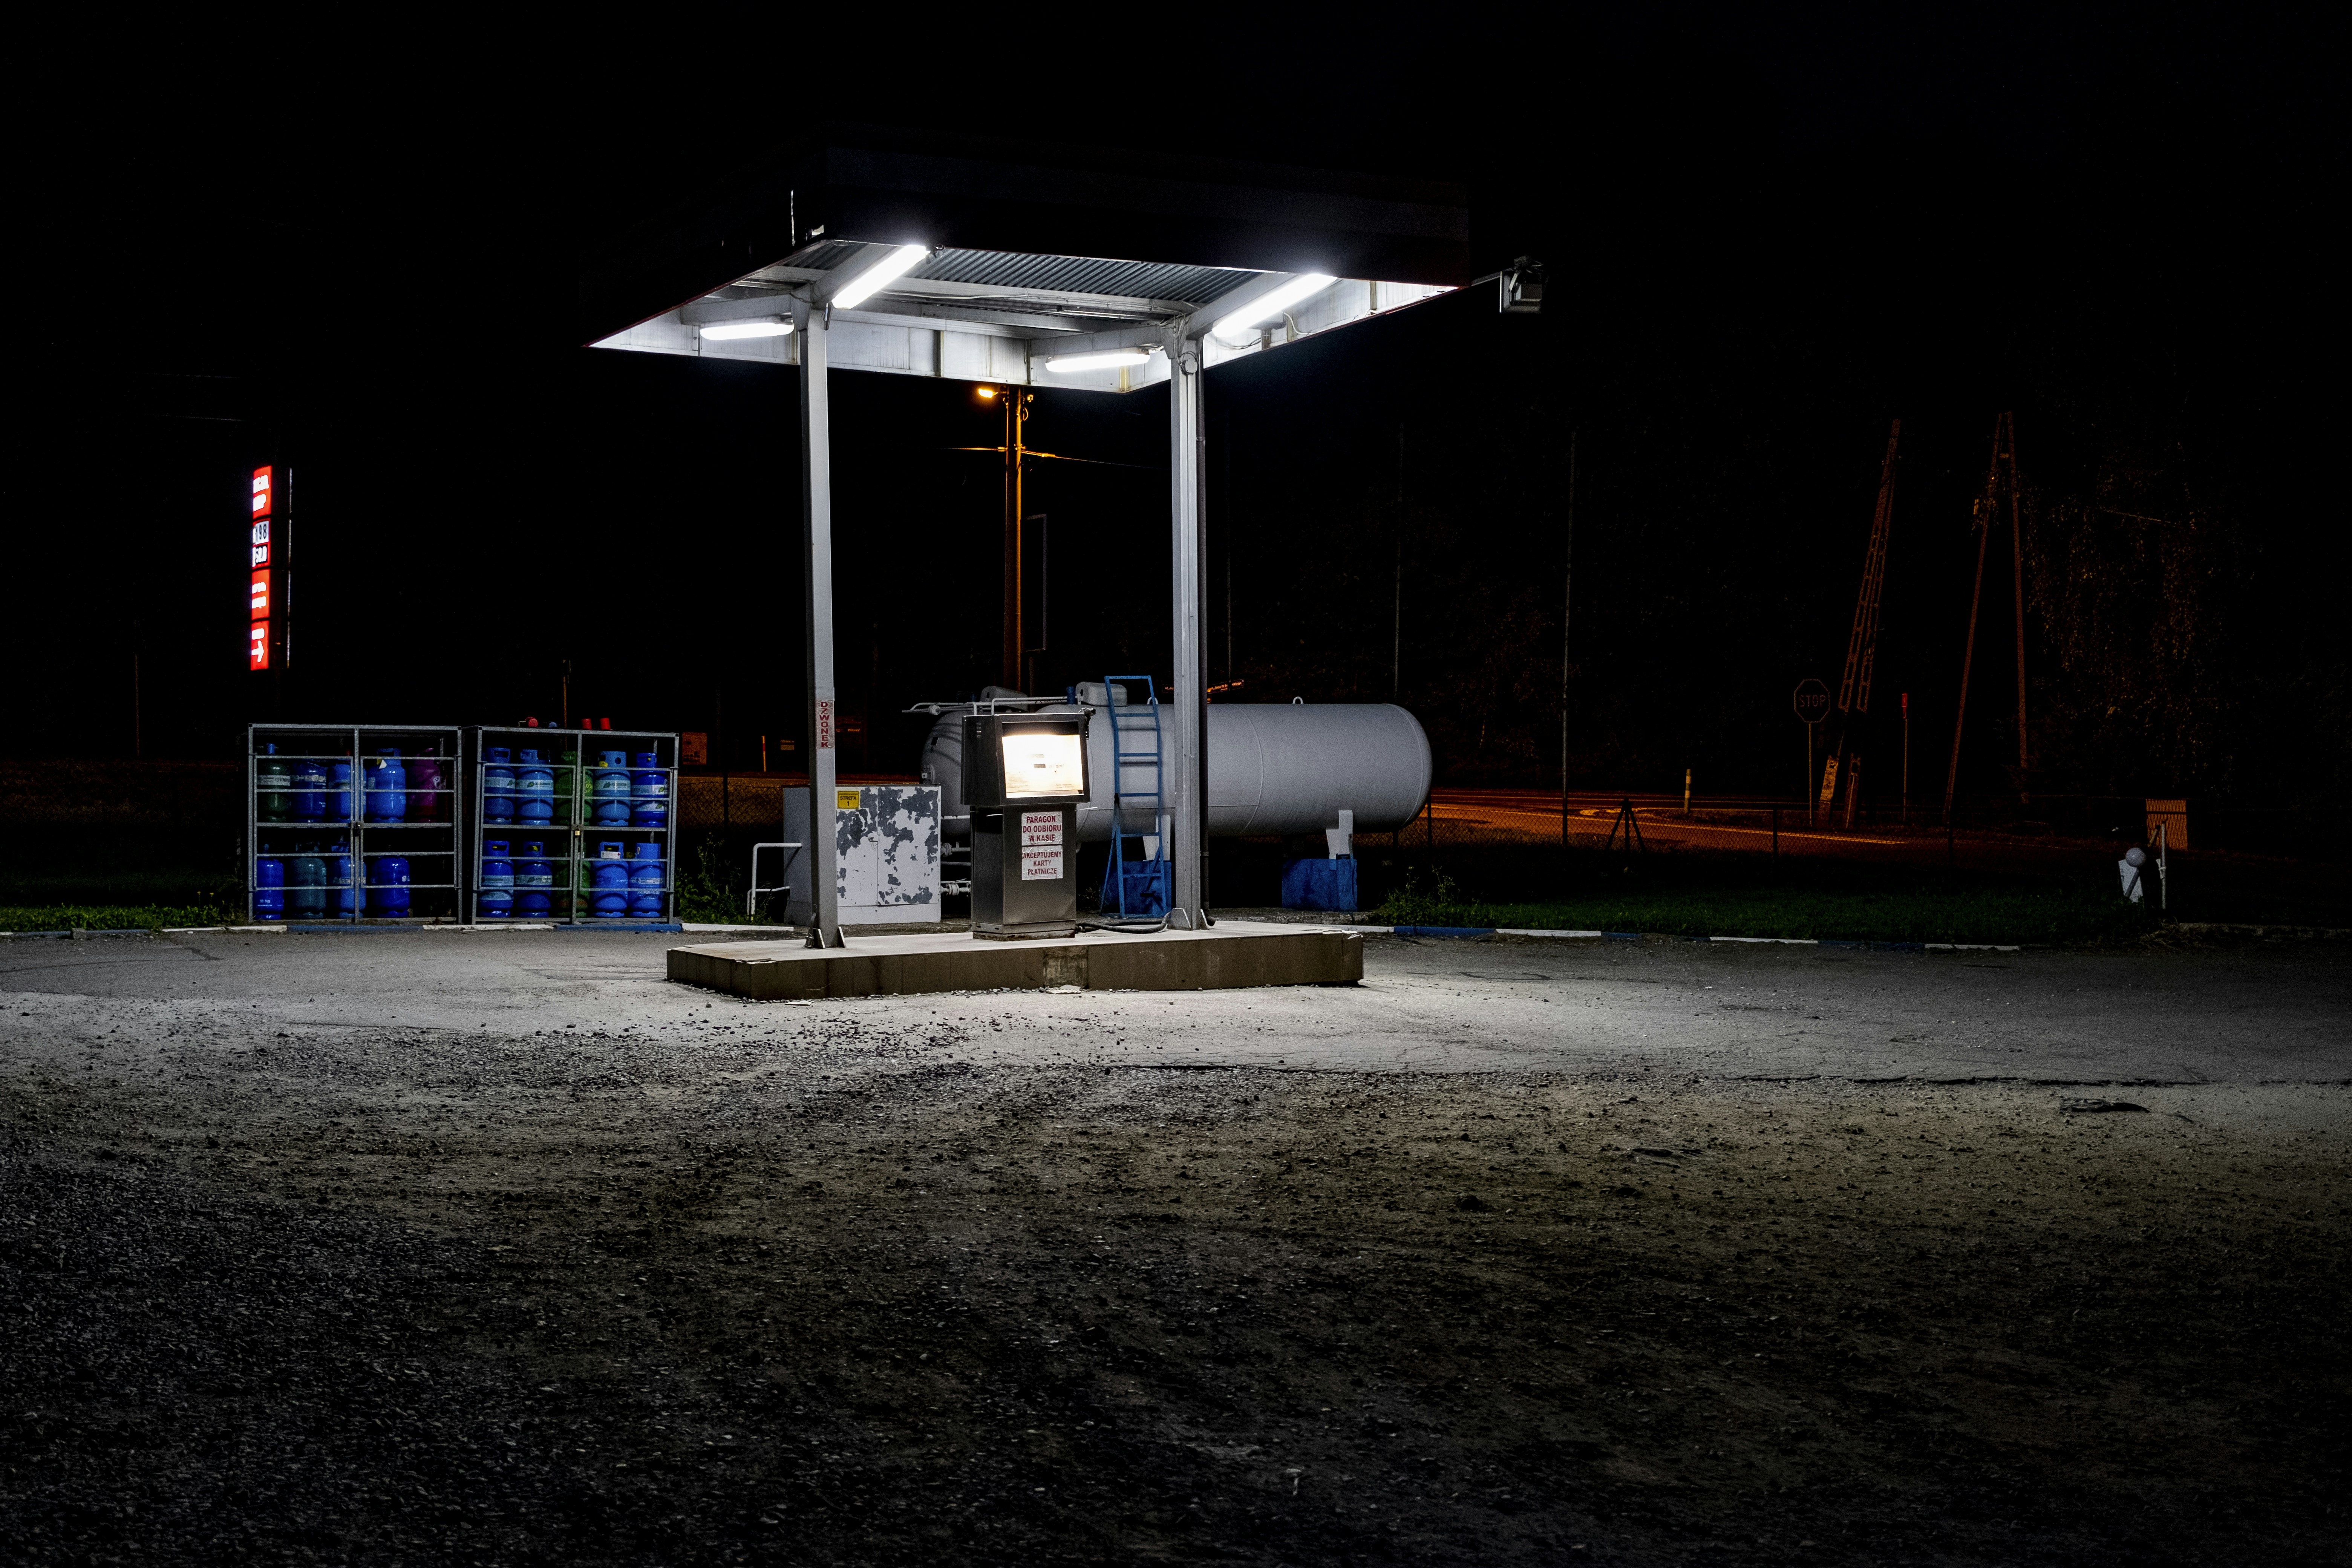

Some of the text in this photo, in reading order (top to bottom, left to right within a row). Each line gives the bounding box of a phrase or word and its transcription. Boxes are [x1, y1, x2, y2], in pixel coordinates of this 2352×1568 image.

[1799, 695, 1826, 707] STOP
[819, 701, 830, 747] DZWONEK
[1034, 824, 1061, 833] ODBIORU
